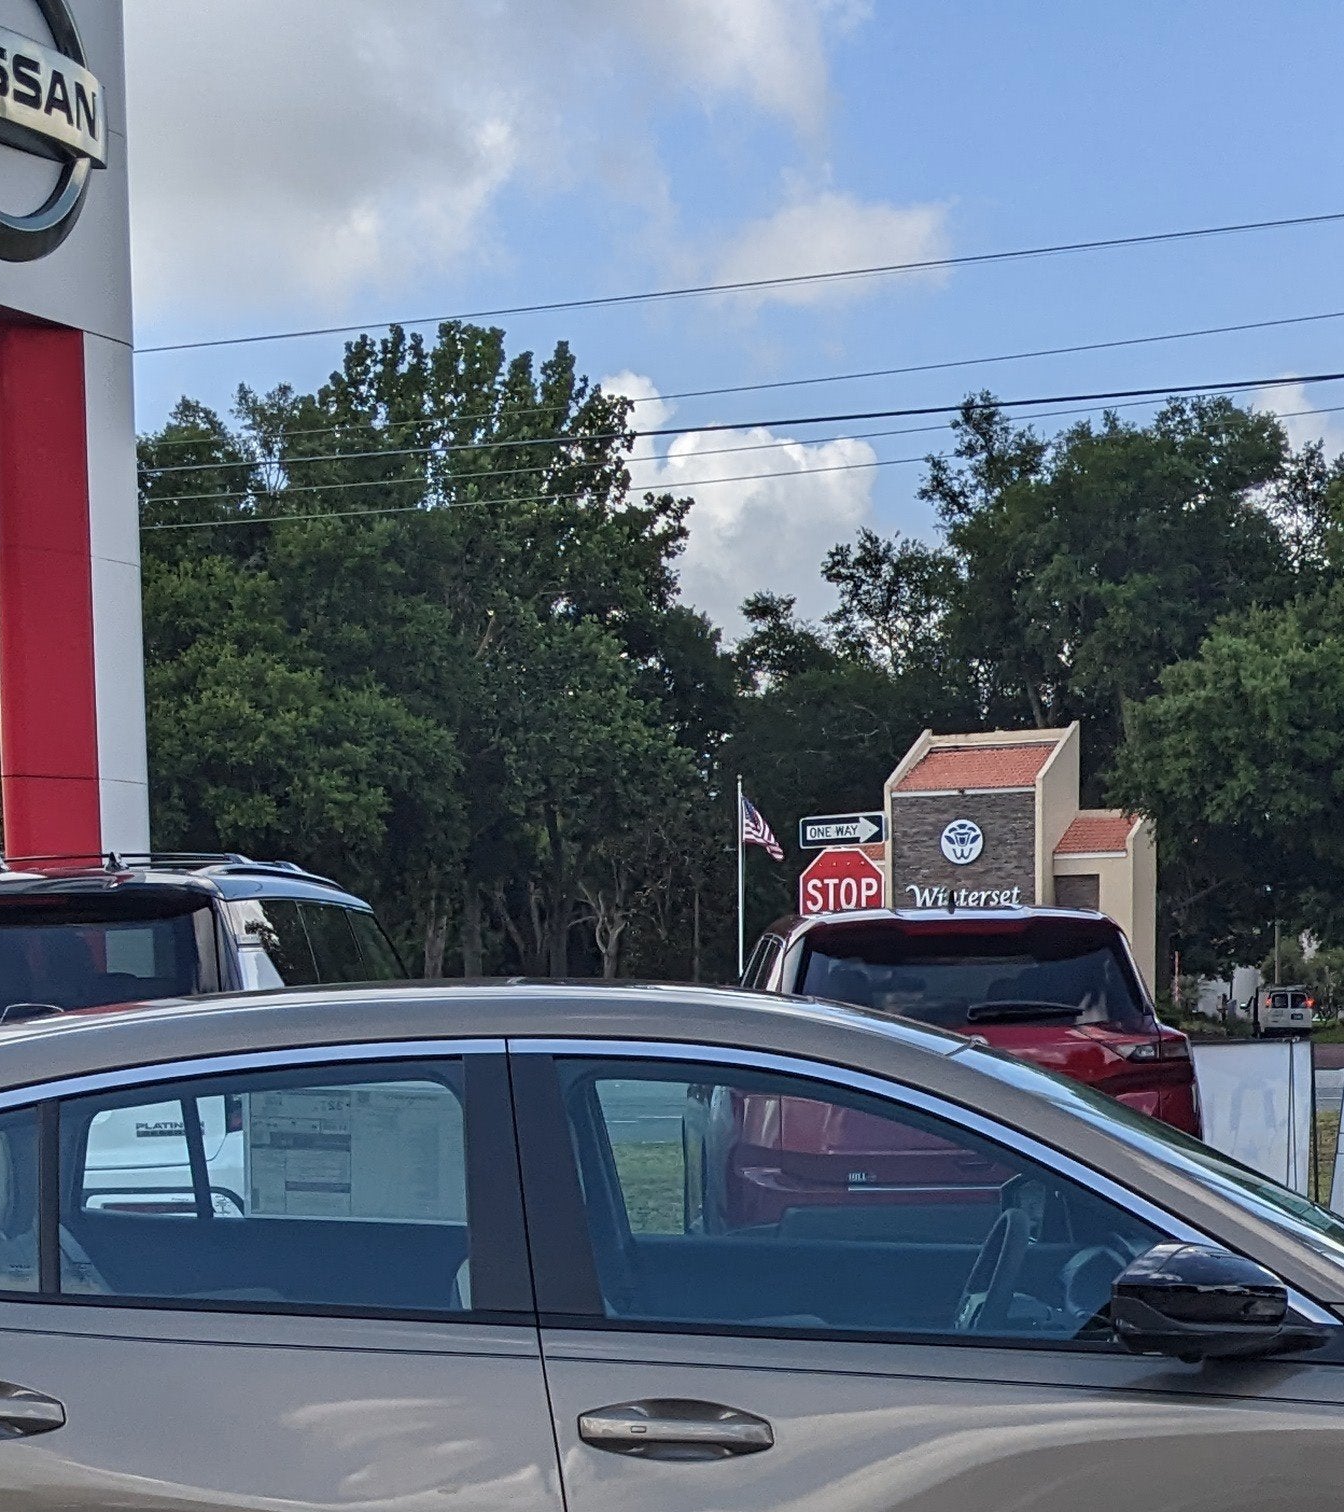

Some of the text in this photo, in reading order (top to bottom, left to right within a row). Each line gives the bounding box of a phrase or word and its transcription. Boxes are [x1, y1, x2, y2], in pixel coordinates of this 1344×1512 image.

[809, 825, 858, 839] ONE WAY
[806, 877, 878, 912] STOP
[136, 1121, 205, 1130] PLATIN
